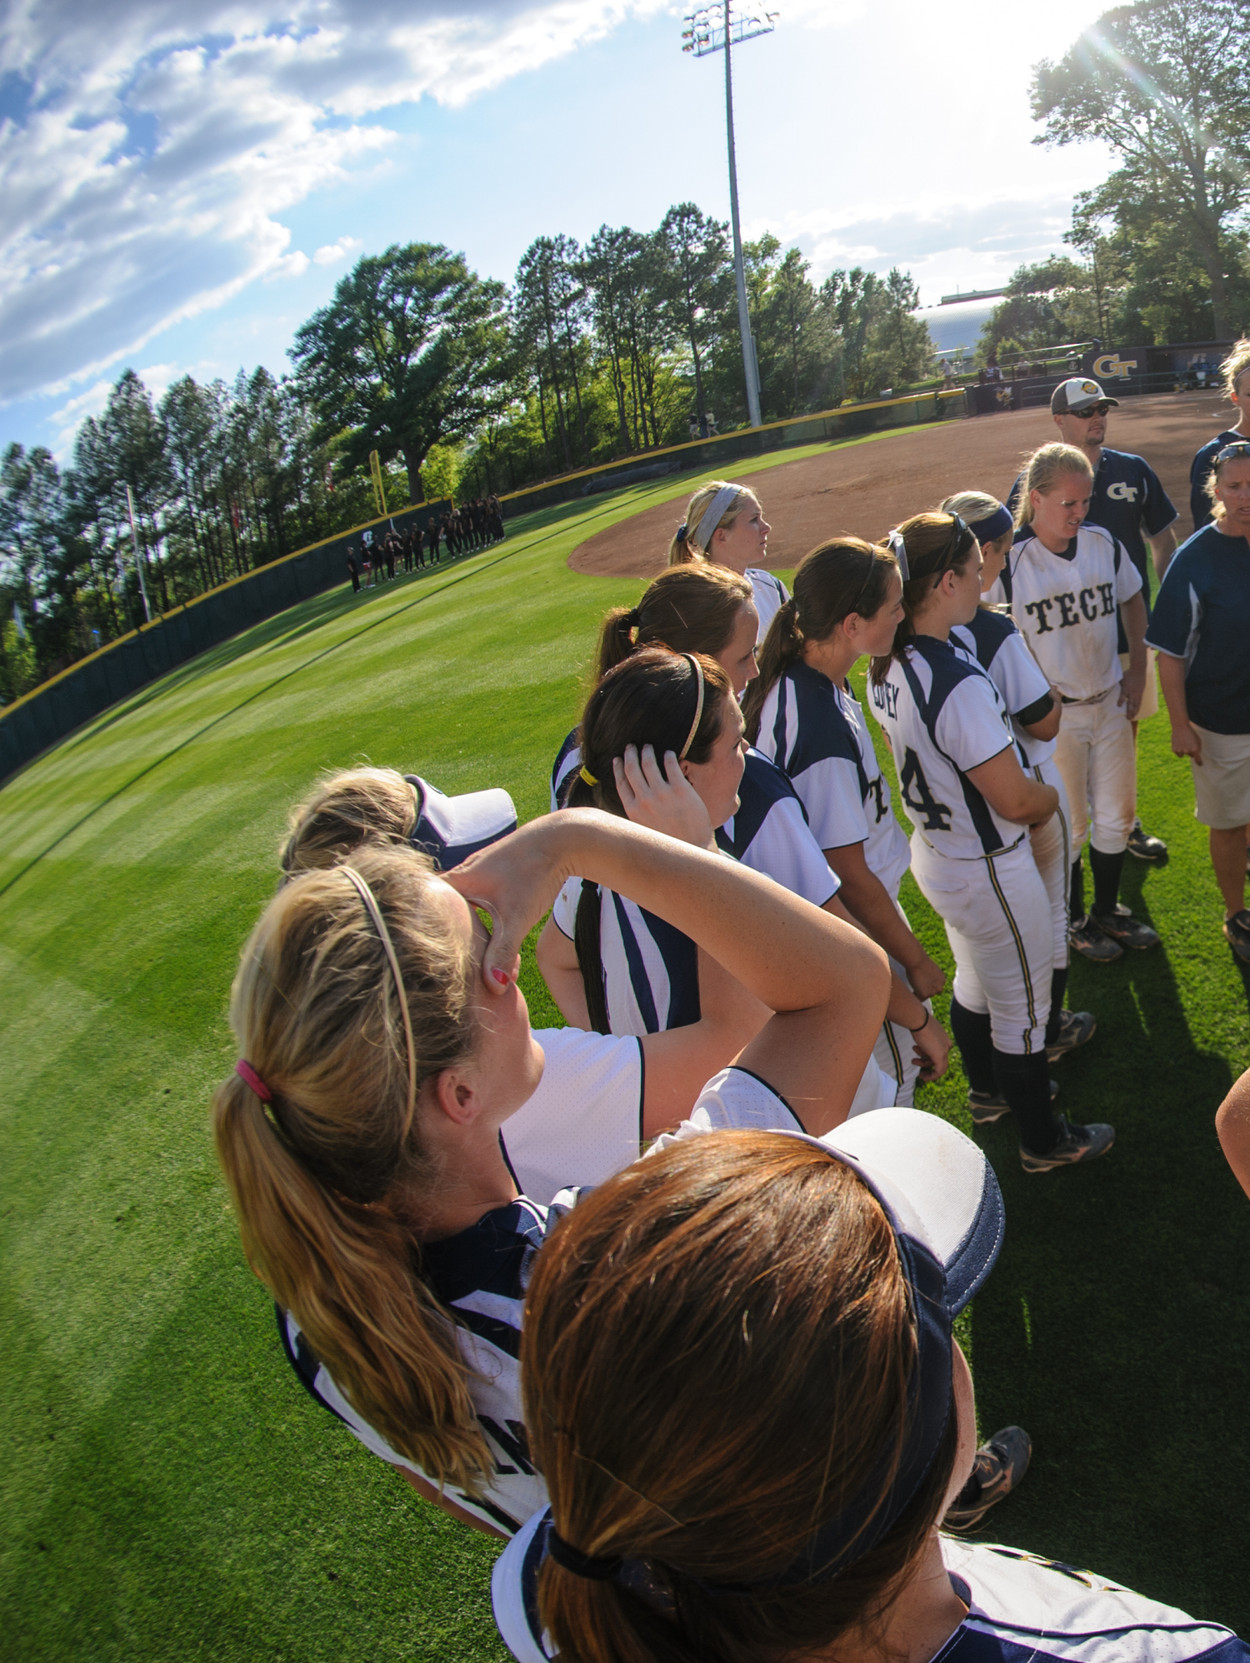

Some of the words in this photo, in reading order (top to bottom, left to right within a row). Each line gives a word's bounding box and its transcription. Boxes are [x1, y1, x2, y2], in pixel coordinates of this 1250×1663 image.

[1093, 354, 1137, 380] GT
[1106, 482, 1138, 502] GT
[1025, 582, 1114, 634] TECH
[901, 746, 952, 832] 4
